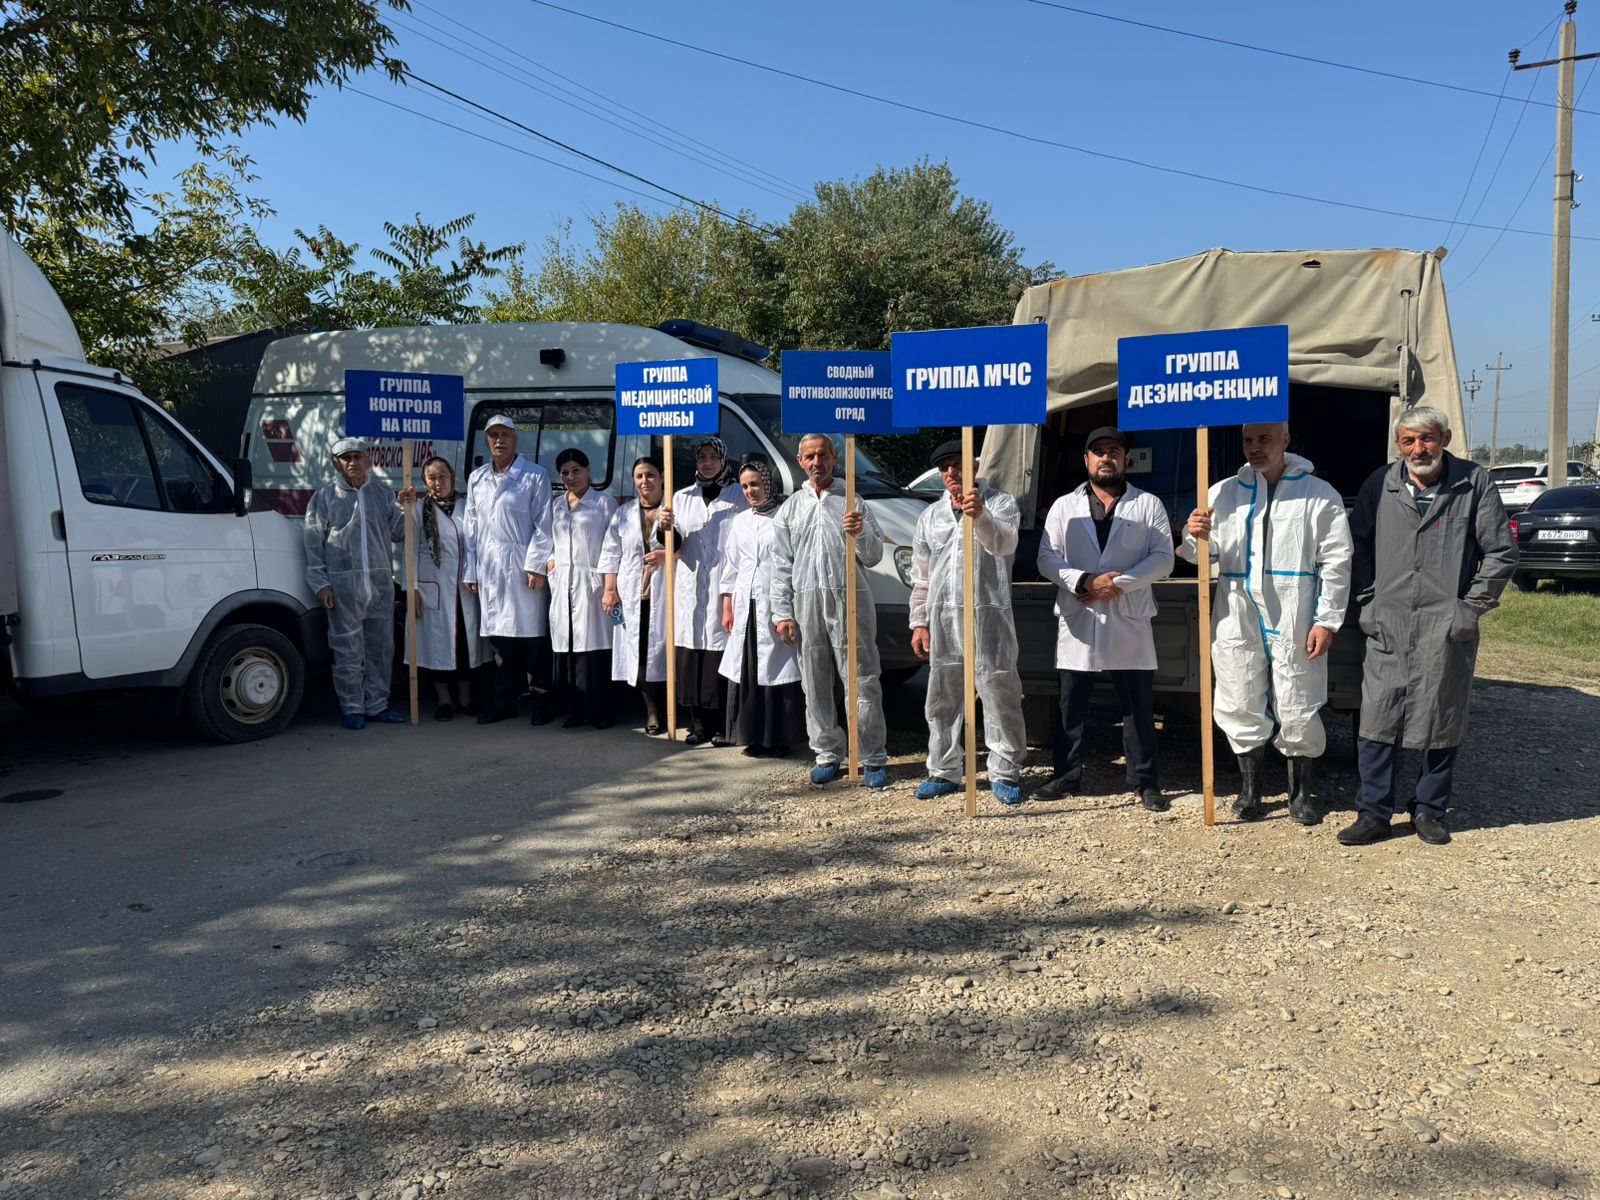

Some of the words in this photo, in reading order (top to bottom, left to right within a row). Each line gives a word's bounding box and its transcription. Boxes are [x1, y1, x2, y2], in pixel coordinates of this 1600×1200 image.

[1165, 350, 1240, 375] ГРУППА
[643, 366, 688, 384] ГРУППА
[827, 364, 874, 380] СВОДНЫЙ
[906, 365, 979, 391] ГРУППА
[984, 362, 1032, 387] МЧС
[380, 377, 431, 394] ГРУППА
[788, 386, 893, 400] ПРОТИВОЭПИЗООТИЧЕС
[1127, 376, 1278, 409] ДЕЗИНФЕКЦИИ
[621, 384, 712, 408] МЕДИЦИНСКОЙ
[369, 397, 442, 414] КОНТРОЛЯ
[835, 407, 865, 421] ОТРЯД
[381, 417, 400, 432] НА
[402, 418, 431, 433] КПП
[639, 411, 694, 428] СЛУЖБЫ
